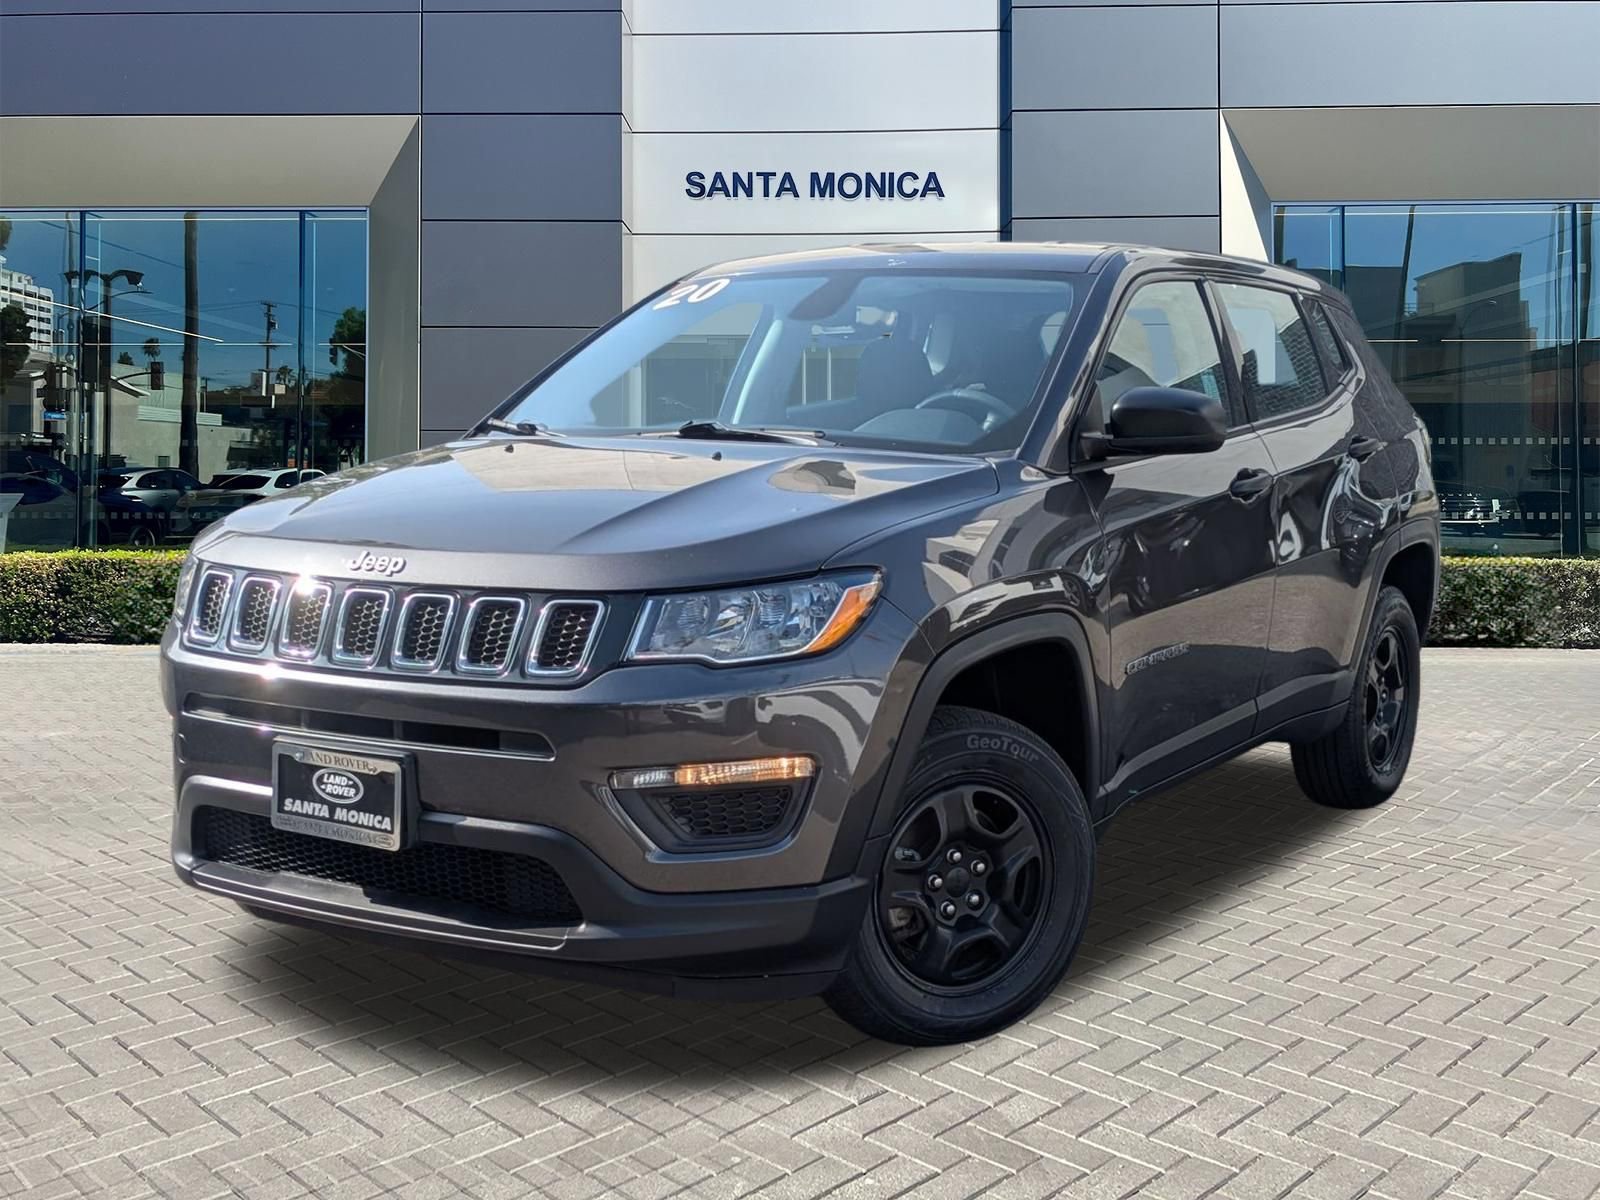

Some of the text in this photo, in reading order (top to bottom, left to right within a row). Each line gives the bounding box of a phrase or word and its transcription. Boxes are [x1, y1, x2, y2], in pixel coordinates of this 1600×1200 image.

[685, 171, 945, 199] SANTA MONICA
[652, 279, 730, 310] 20
[345, 550, 406, 577] Jeep
[967, 734, 1039, 762] GeoTour
[334, 755, 371, 771] ROVER
[323, 773, 348, 786] LAND
[325, 784, 356, 798] ROVER
[283, 798, 392, 831] SANTA MONICA
